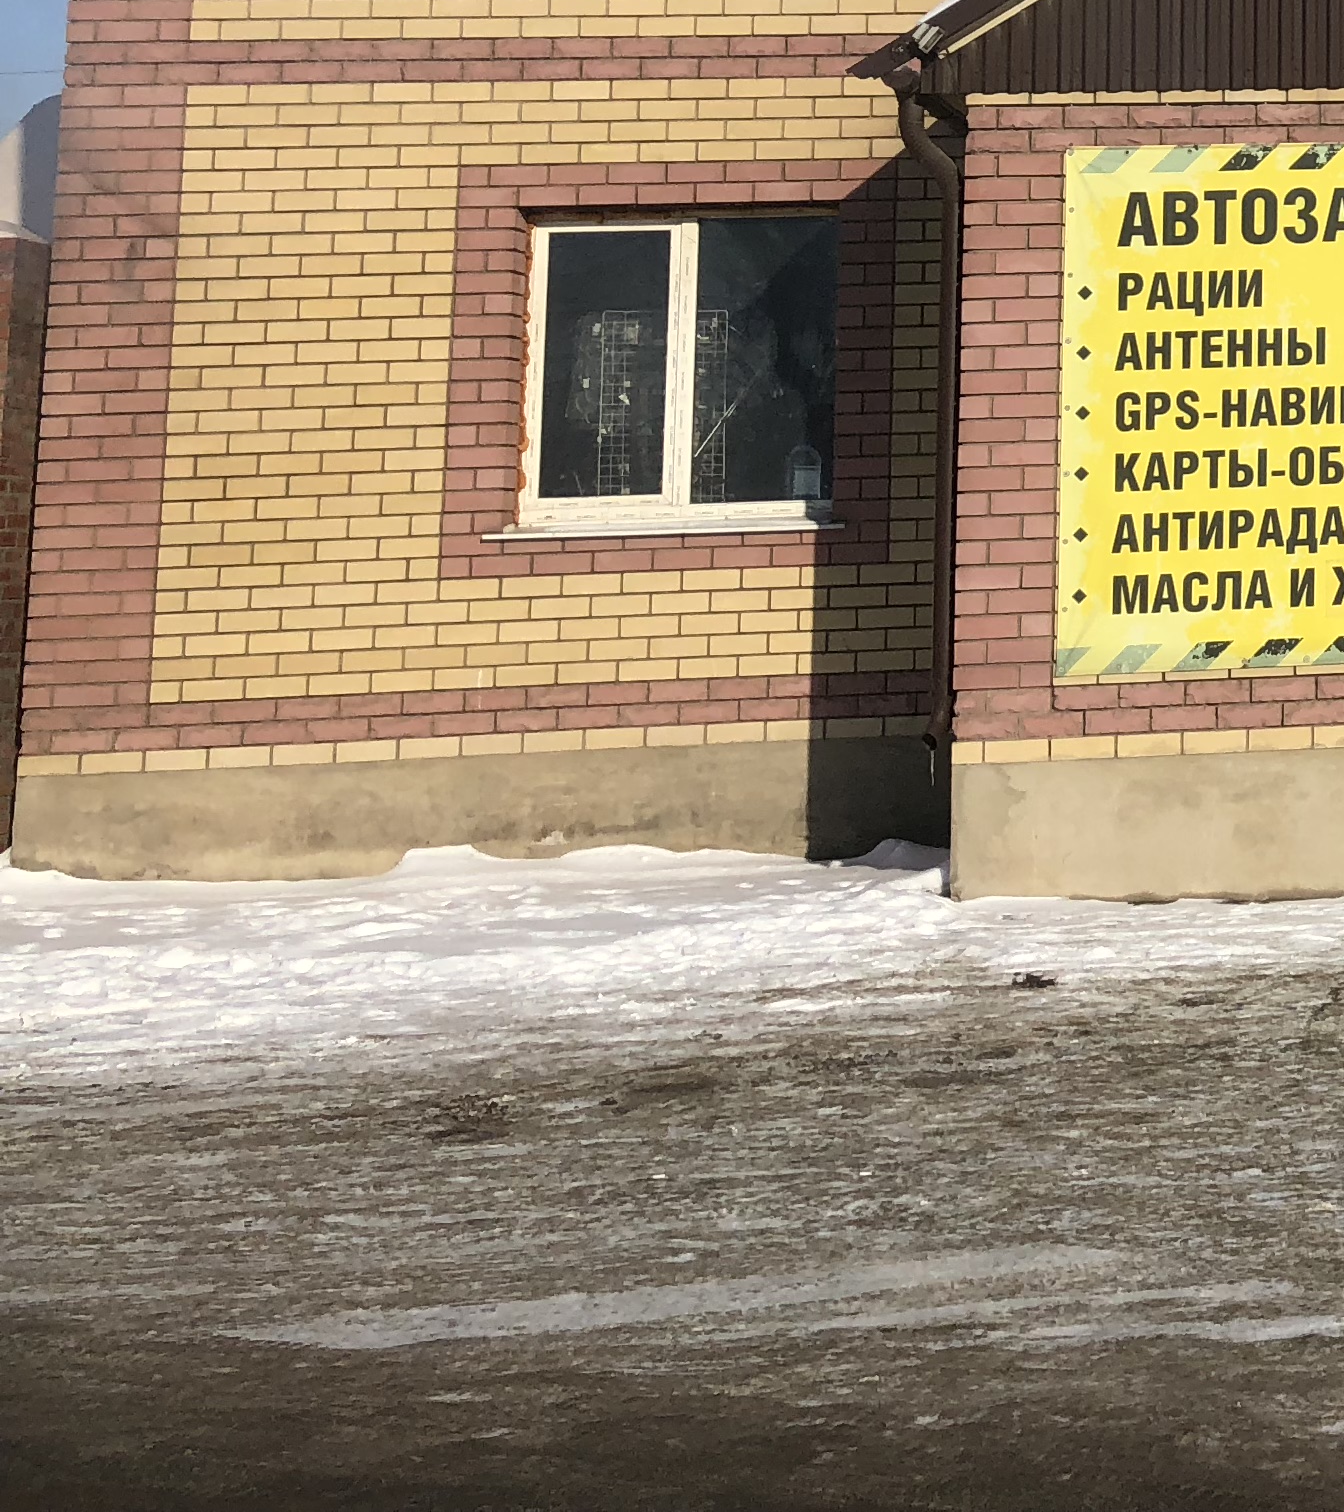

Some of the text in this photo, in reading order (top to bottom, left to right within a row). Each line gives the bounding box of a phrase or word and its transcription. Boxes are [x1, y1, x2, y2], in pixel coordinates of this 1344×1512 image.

[1117, 269, 1263, 317] РАЦИИ
[1114, 326, 1326, 372] АНТЕННЫ
[1112, 569, 1273, 615] МАСЛА
[1289, 567, 1315, 608] И
